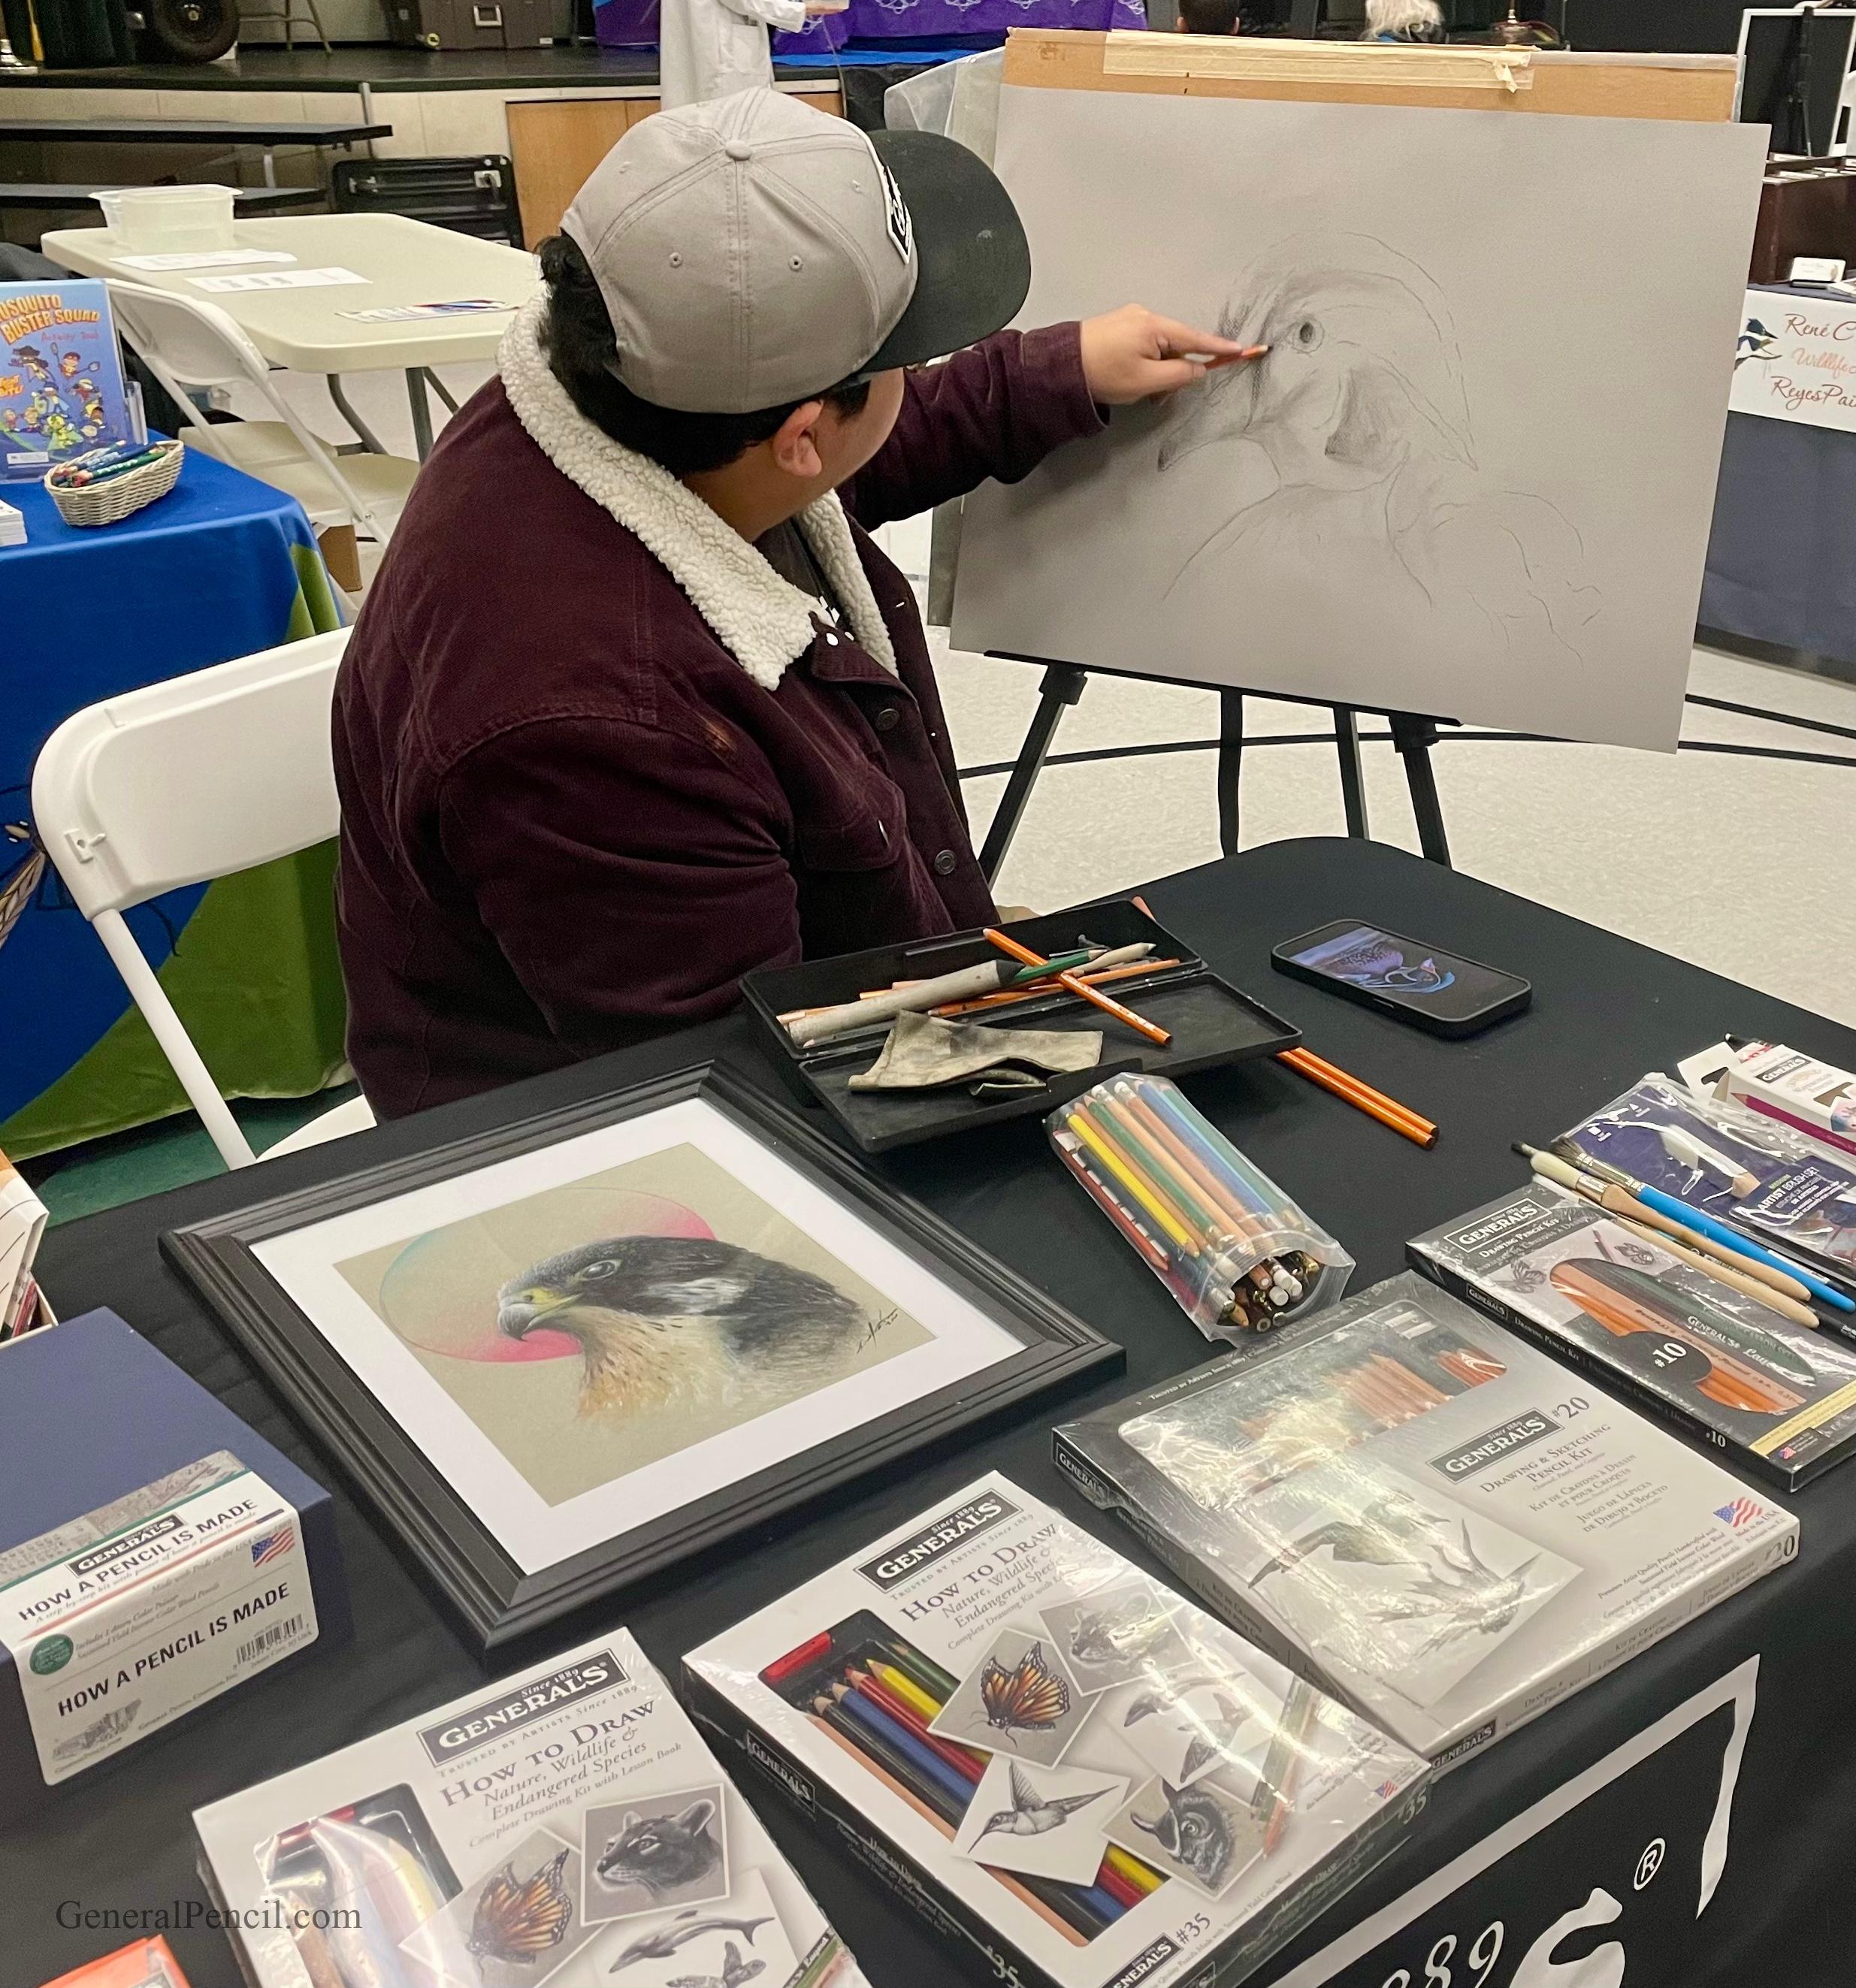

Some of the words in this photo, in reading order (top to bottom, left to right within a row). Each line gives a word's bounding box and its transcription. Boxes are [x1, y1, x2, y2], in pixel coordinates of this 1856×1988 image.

[0, 294, 62, 322] OSQUITO
[0, 310, 53, 345] BUSTER
[54, 309, 101, 324] SQUAD
[1785, 313, 1830, 337] René
[1758, 1188, 1786, 1210] ARTIST
[1652, 1342, 1688, 1368] #10
[1552, 1396, 1590, 1418] #20
[1444, 1418, 1546, 1473] GENERAL'S
[1539, 1455, 1548, 1464] &
[18, 1588, 71, 1621] HOW
[78, 1580, 95, 1593] A
[95, 1542, 171, 1582] PENCIL
[171, 1530, 194, 1545] IS
[196, 1499, 258, 1533] MADE
[78, 1518, 177, 1570] GENERAL'S
[876, 1501, 1002, 1579] GENERAL'S
[1765, 1535, 1795, 1564] 20
[899, 1582, 960, 1623] HOW
[963, 1564, 994, 1585] TO
[941, 1589, 991, 1619] Nature,
[987, 1555, 1038, 1588] Wildlife
[954, 1582, 1026, 1629] Endangered
[58, 1678, 109, 1717] HOW
[117, 1670, 131, 1687] A
[135, 1630, 206, 1677] PENCIL
[209, 1616, 228, 1636] IS
[232, 1582, 290, 1624] MADE
[438, 1664, 609, 1749] GENERAL'S
[440, 1763, 516, 1807] HOW
[525, 1743, 564, 1768] TO
[570, 1699, 656, 1746] DRAW
[484, 1771, 548, 1808] Nature,
[550, 1736, 617, 1774] Wildlife
[621, 1726, 638, 1742] &
[470, 1816, 520, 1848] Complete
[523, 1793, 574, 1823] Drawing
[575, 1783, 593, 1799] Kit
[594, 1772, 620, 1790] with
[621, 1757, 655, 1779] Lesson
[656, 1742, 683, 1762] Book
[491, 1767, 589, 1821] Endangered
[593, 1740, 648, 1775] Species
[1176, 1912, 1211, 1944] #35
[1113, 1942, 1172, 1988] ENERAL'S
